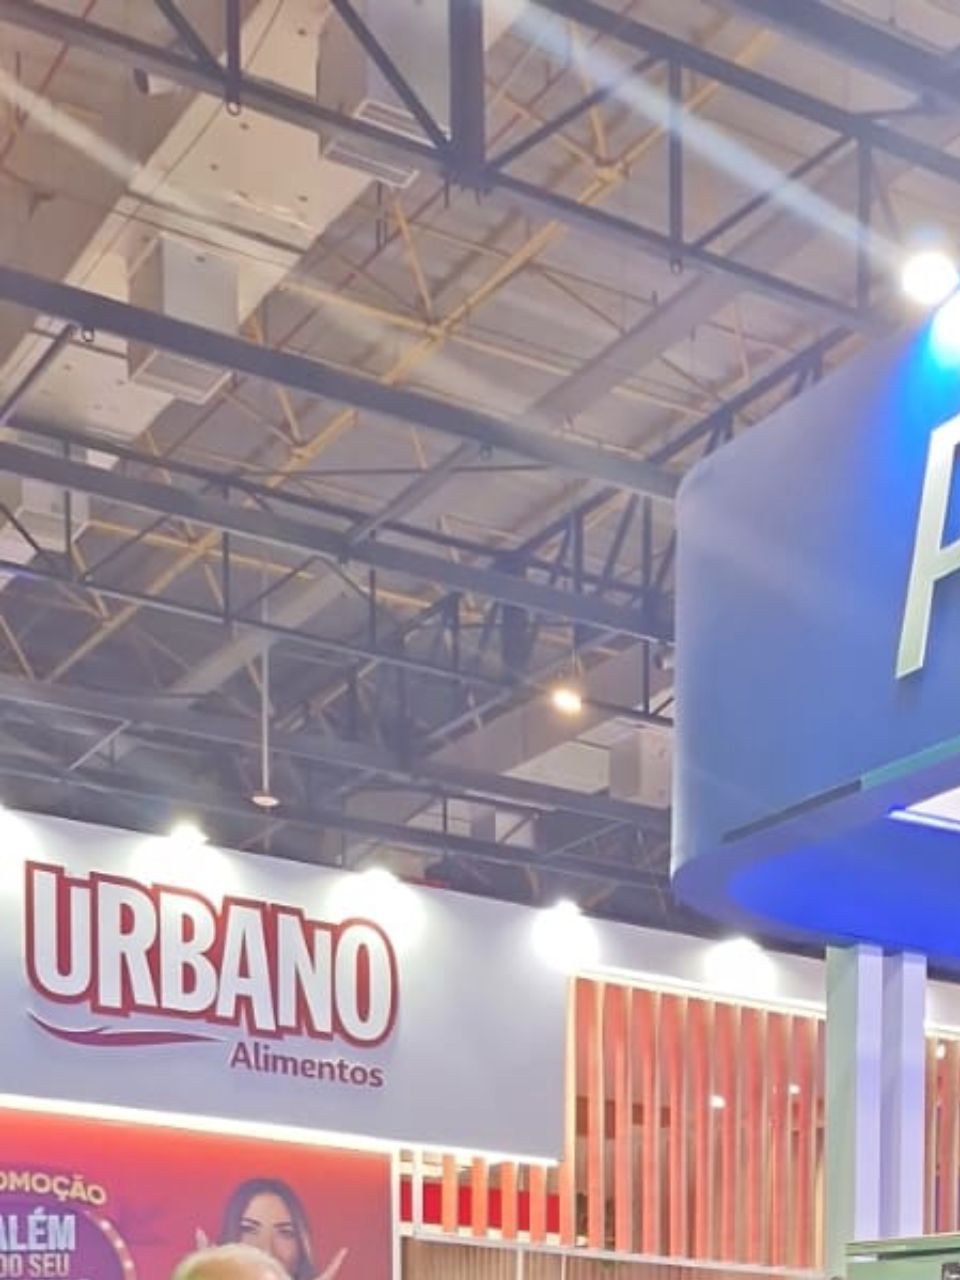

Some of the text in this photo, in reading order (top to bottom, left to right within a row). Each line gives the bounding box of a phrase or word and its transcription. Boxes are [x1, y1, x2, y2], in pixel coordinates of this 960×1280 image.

[25, 860, 399, 1048] URBANO
[230, 1041, 385, 1088] Alimentos
[29, 1253, 71, 1278] SEU
